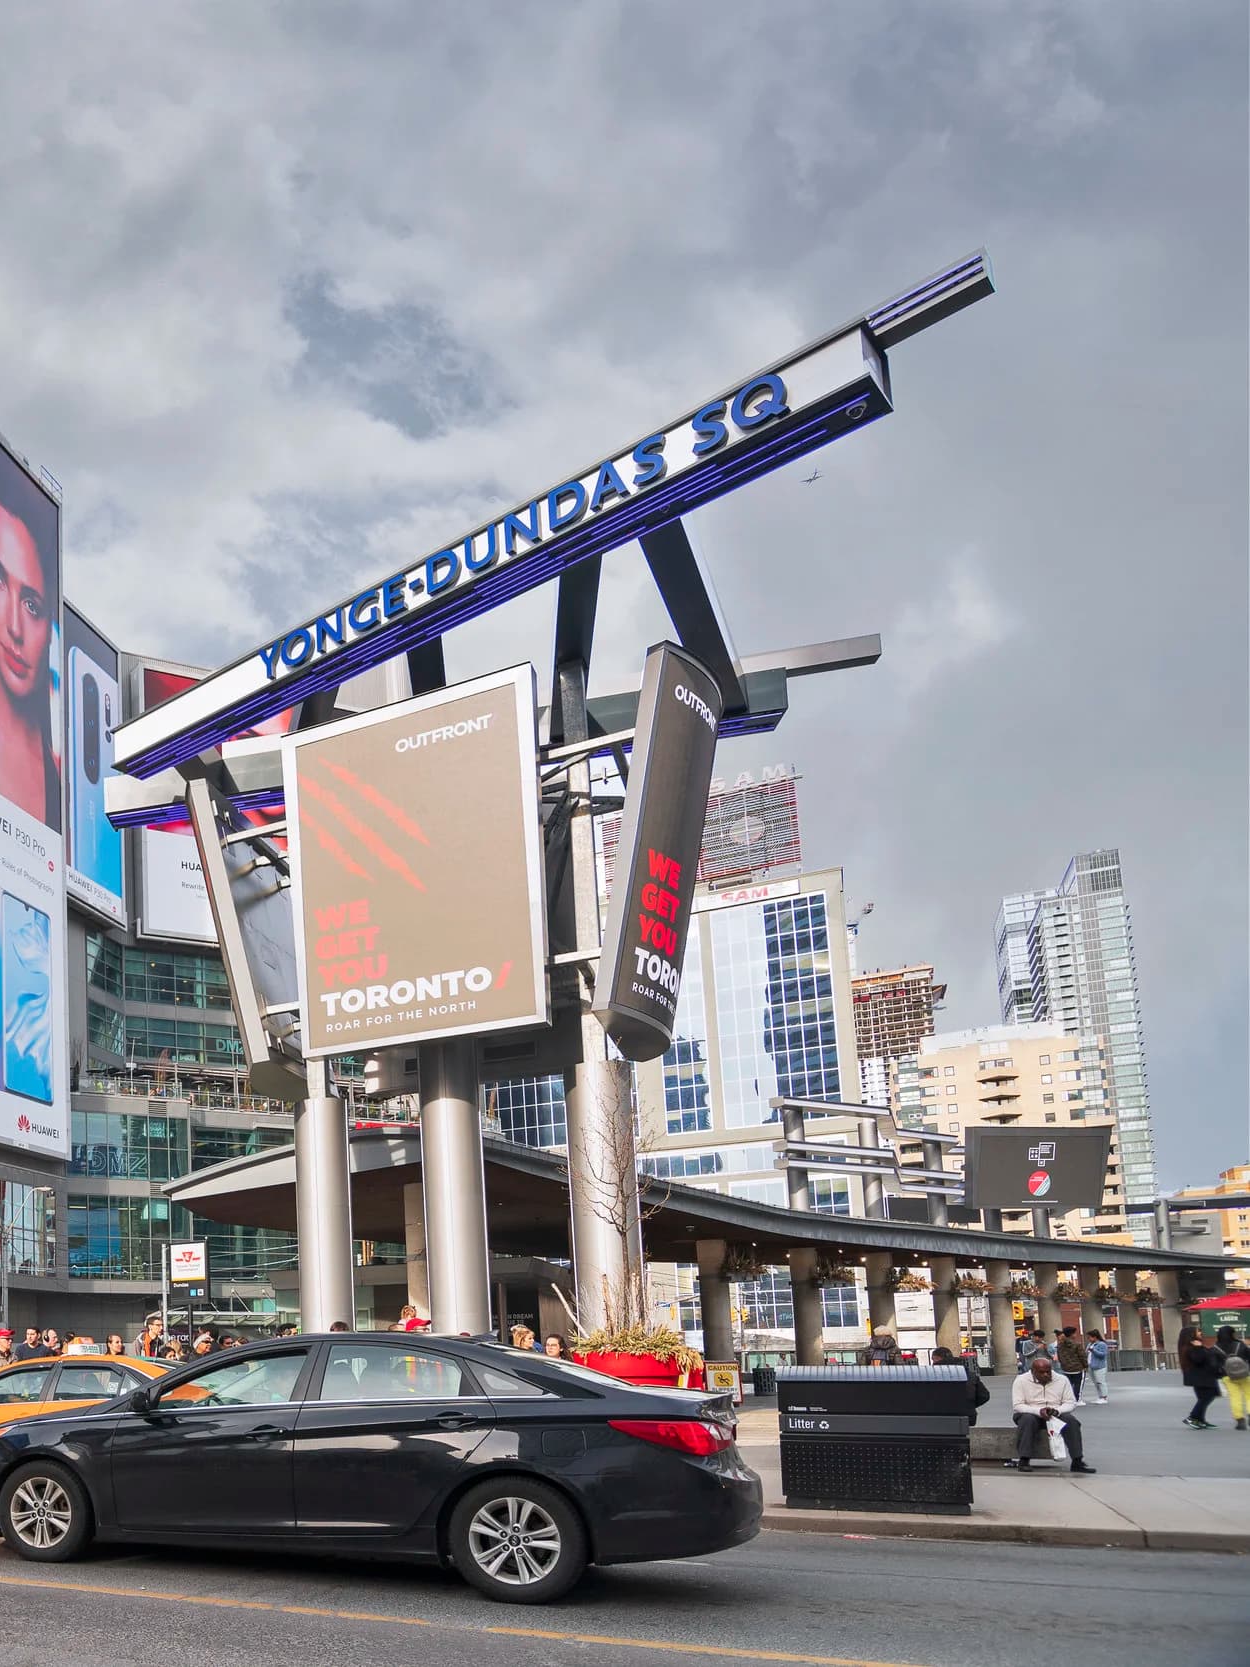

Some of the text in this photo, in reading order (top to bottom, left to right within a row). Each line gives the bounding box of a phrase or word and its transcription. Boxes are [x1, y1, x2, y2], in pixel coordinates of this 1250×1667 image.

[257, 373, 793, 680] YONGE-DUNDAS SQ
[394, 712, 493, 753] OUTFRONT
[15, 826, 31, 849] P30
[33, 837, 46, 857] Pro
[68, 871, 93, 892] HUAWEI
[181, 860, 203, 872] HUA
[647, 847, 682, 891] WE
[641, 882, 681, 924] GET
[721, 886, 769, 903] SAM
[313, 898, 371, 932] WE
[314, 925, 381, 960] GET
[638, 913, 678, 958] YOU
[317, 953, 389, 988] YOU
[320, 966, 493, 1017] TORONTO
[631, 981, 655, 1001] ROAR
[655, 991, 669, 1007] FOR
[325, 1000, 477, 1033] ROAR FOR THE NORTH
[31, 1123, 60, 1139] HUAWEI
[788, 1417, 815, 1429] Litter
